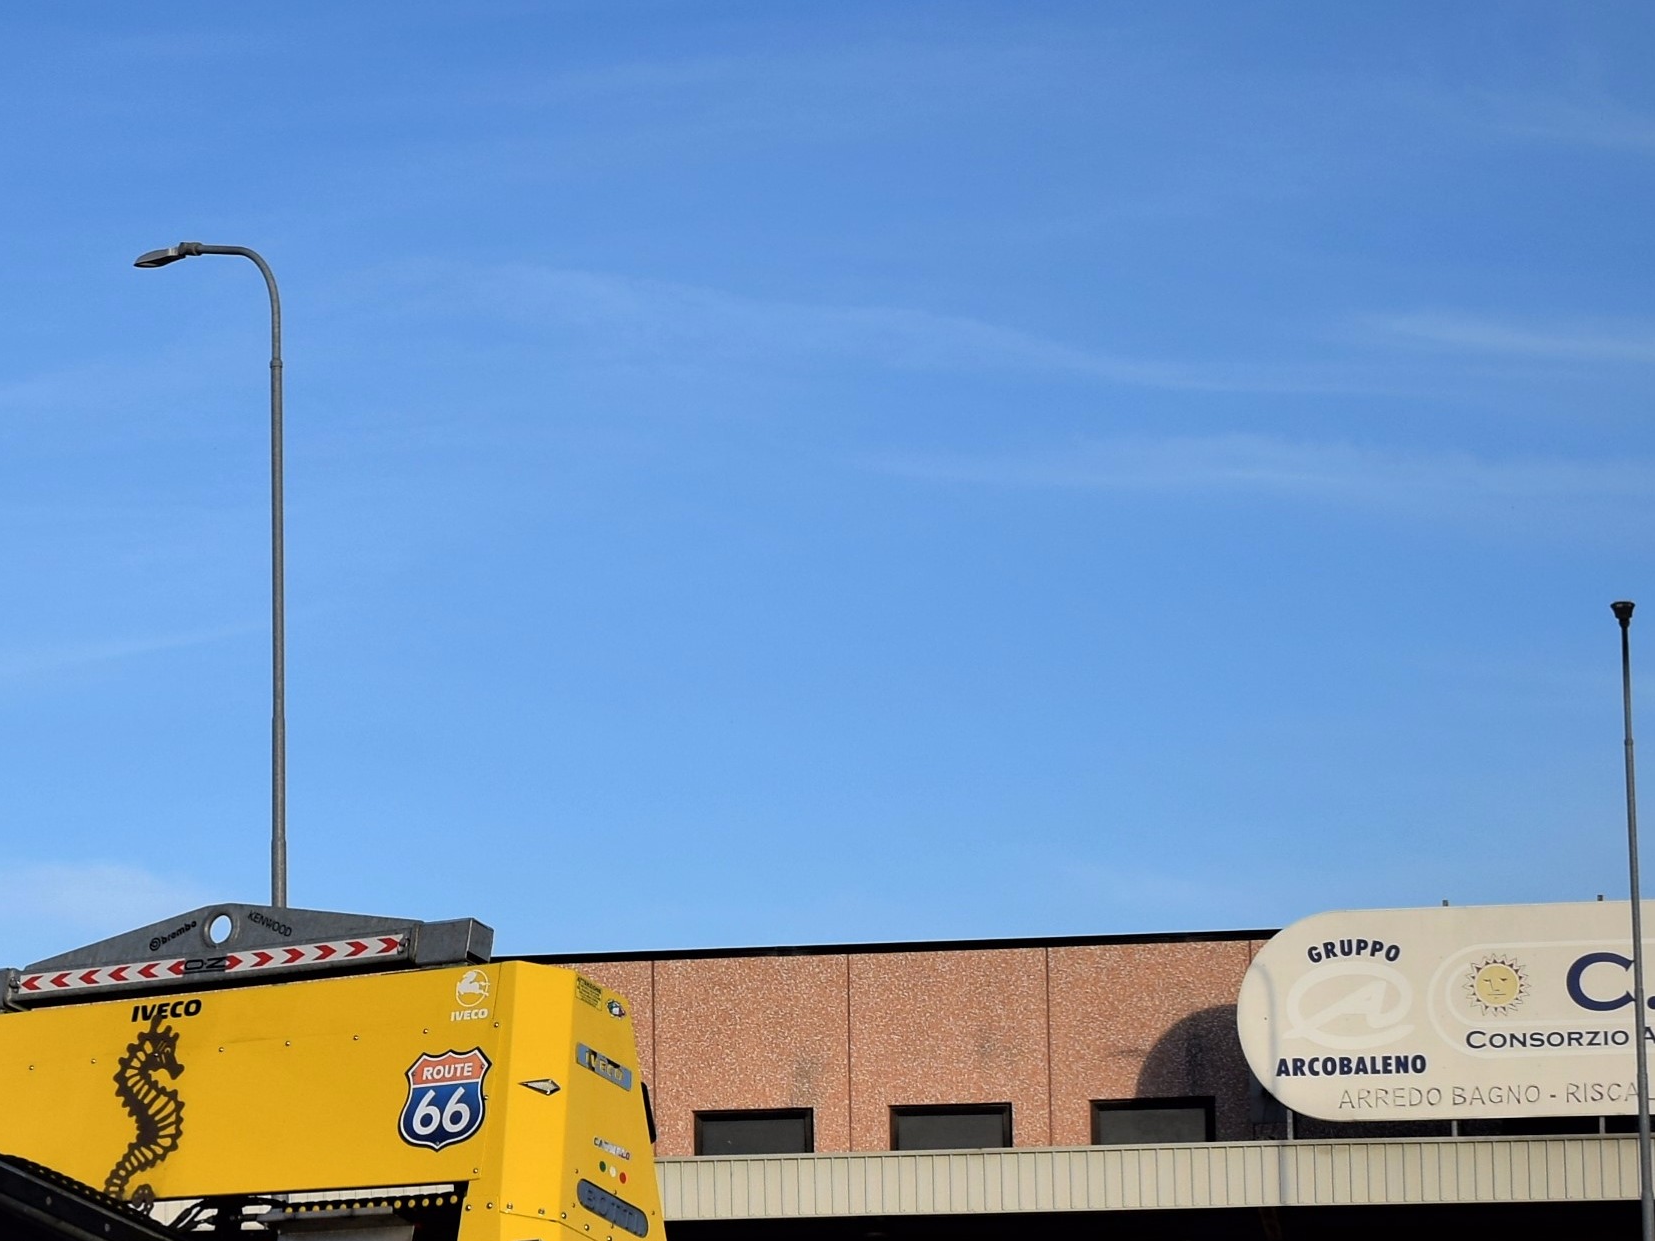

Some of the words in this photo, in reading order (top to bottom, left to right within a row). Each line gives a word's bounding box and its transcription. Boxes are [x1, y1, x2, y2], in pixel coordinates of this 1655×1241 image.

[161, 920, 197, 945] brembo
[247, 910, 293, 938] KENWOOD
[1307, 938, 1401, 964] GRUPPO
[131, 999, 203, 1023] IVECO
[450, 1008, 489, 1022] IVECO
[422, 1061, 474, 1081] ROUTE
[585, 1049, 624, 1082] IVECO
[1275, 1054, 1427, 1077] ARCOBALENO
[1338, 1086, 1442, 1109] ARREDO
[1452, 1084, 1541, 1106] BAGNO
[412, 1086, 471, 1136] 66
